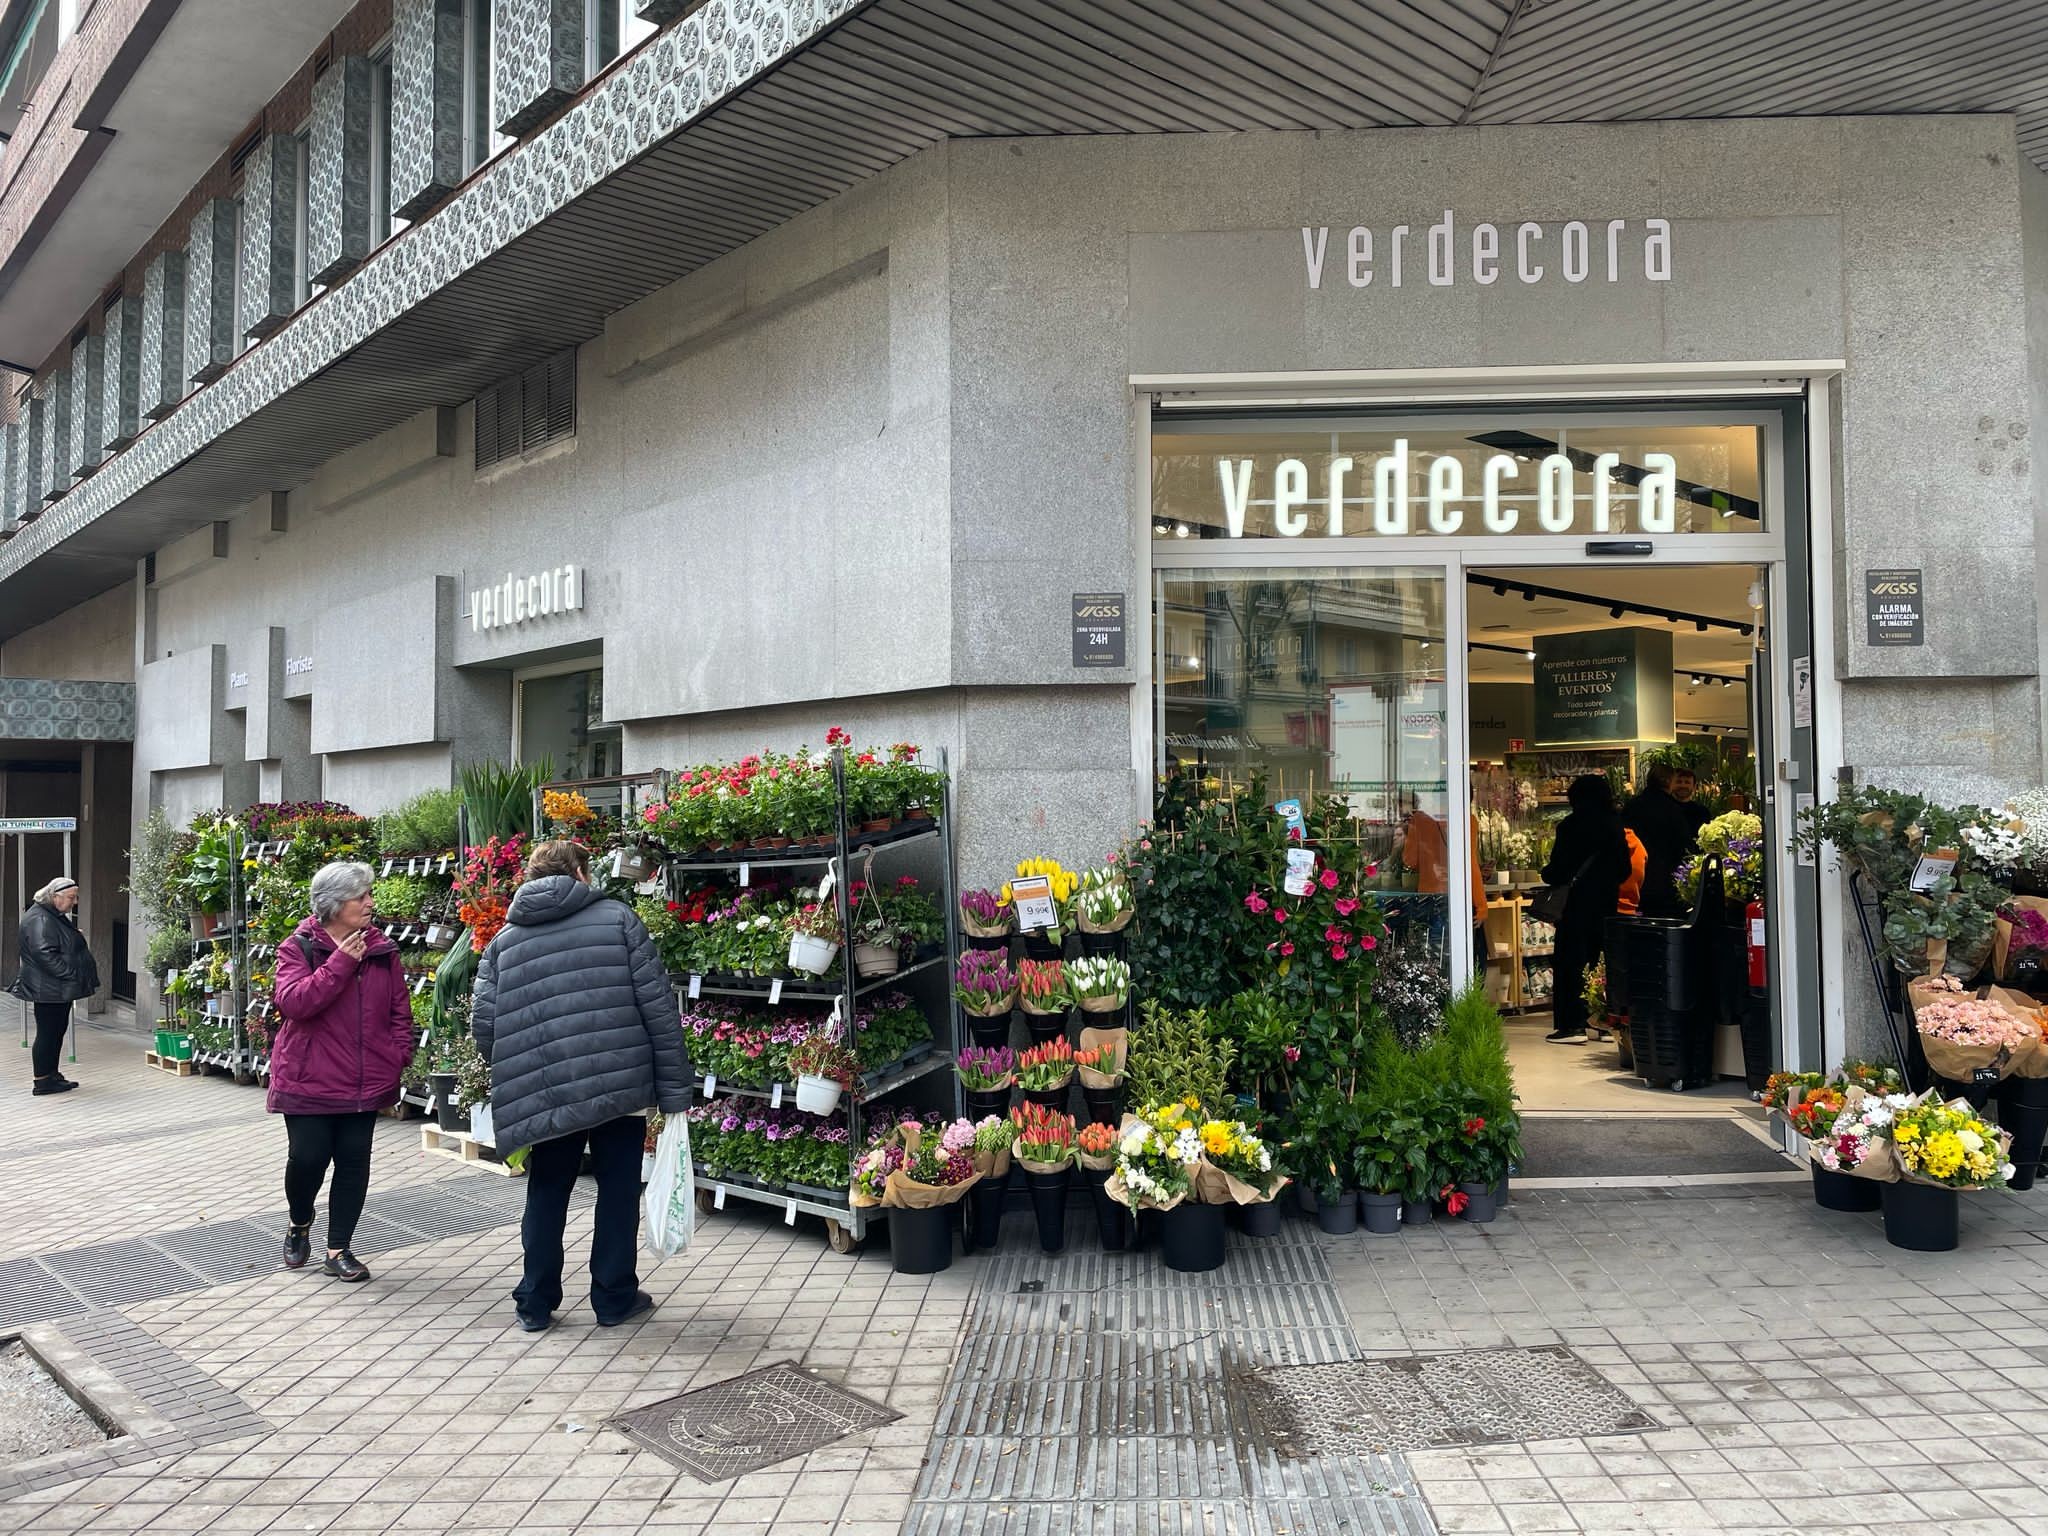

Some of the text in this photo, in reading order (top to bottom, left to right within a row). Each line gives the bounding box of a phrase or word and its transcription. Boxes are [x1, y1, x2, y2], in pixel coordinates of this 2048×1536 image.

[1301, 209, 1672, 289] verdecora
[1218, 438, 1676, 538] verdecora
[1888, 582, 1918, 595] GSS
[471, 564, 579, 633] verdecora
[1092, 605, 1121, 618] GSS
[1879, 604, 1913, 614] ALARMA
[1089, 633, 1109, 645] 24H
[1542, 655, 1627, 670] Aprende con nuestros
[1551, 670, 1617, 683] TALLERES y
[1558, 682, 1612, 696] EVENTOS
[1593, 708, 1619, 717] plantas
